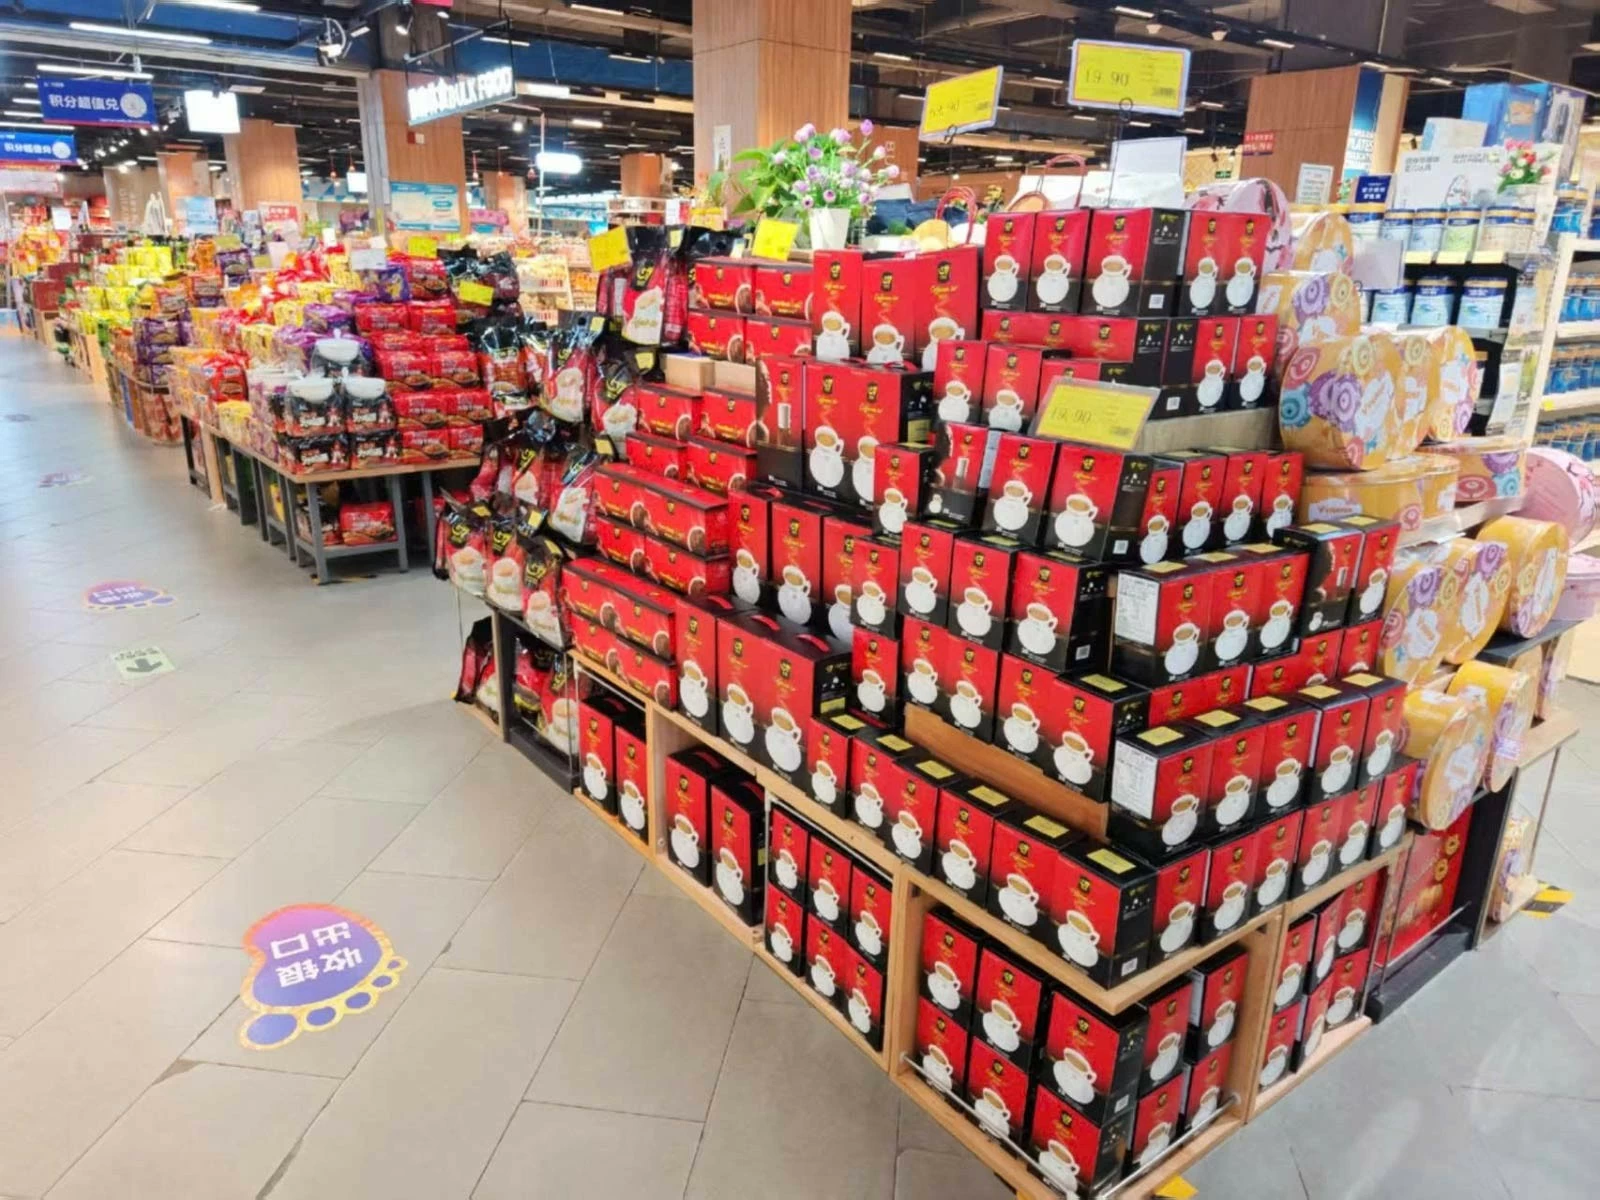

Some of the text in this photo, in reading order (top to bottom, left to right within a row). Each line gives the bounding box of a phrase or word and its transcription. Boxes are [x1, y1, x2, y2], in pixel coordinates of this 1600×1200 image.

[606, 378, 627, 395] G7
[493, 530, 513, 546] G7
[526, 562, 547, 577] G7
[270, 921, 352, 960] 出口
[275, 947, 363, 988] 收银
